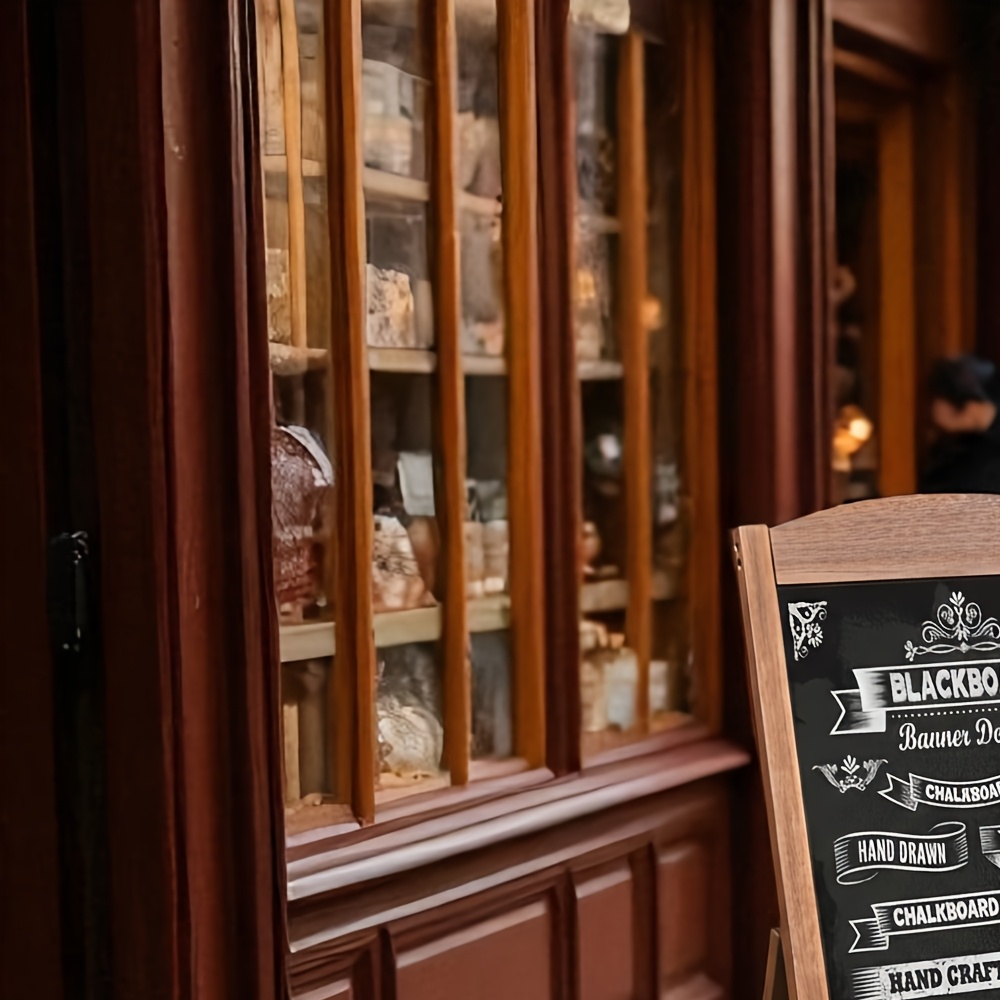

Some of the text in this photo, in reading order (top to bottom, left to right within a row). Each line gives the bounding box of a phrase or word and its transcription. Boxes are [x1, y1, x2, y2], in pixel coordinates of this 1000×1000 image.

[899, 723, 971, 751] Banner
[858, 840, 947, 865] HAND DRAWN
[893, 897, 1000, 926] CHALKBOARD
[889, 967, 943, 994] HAND
